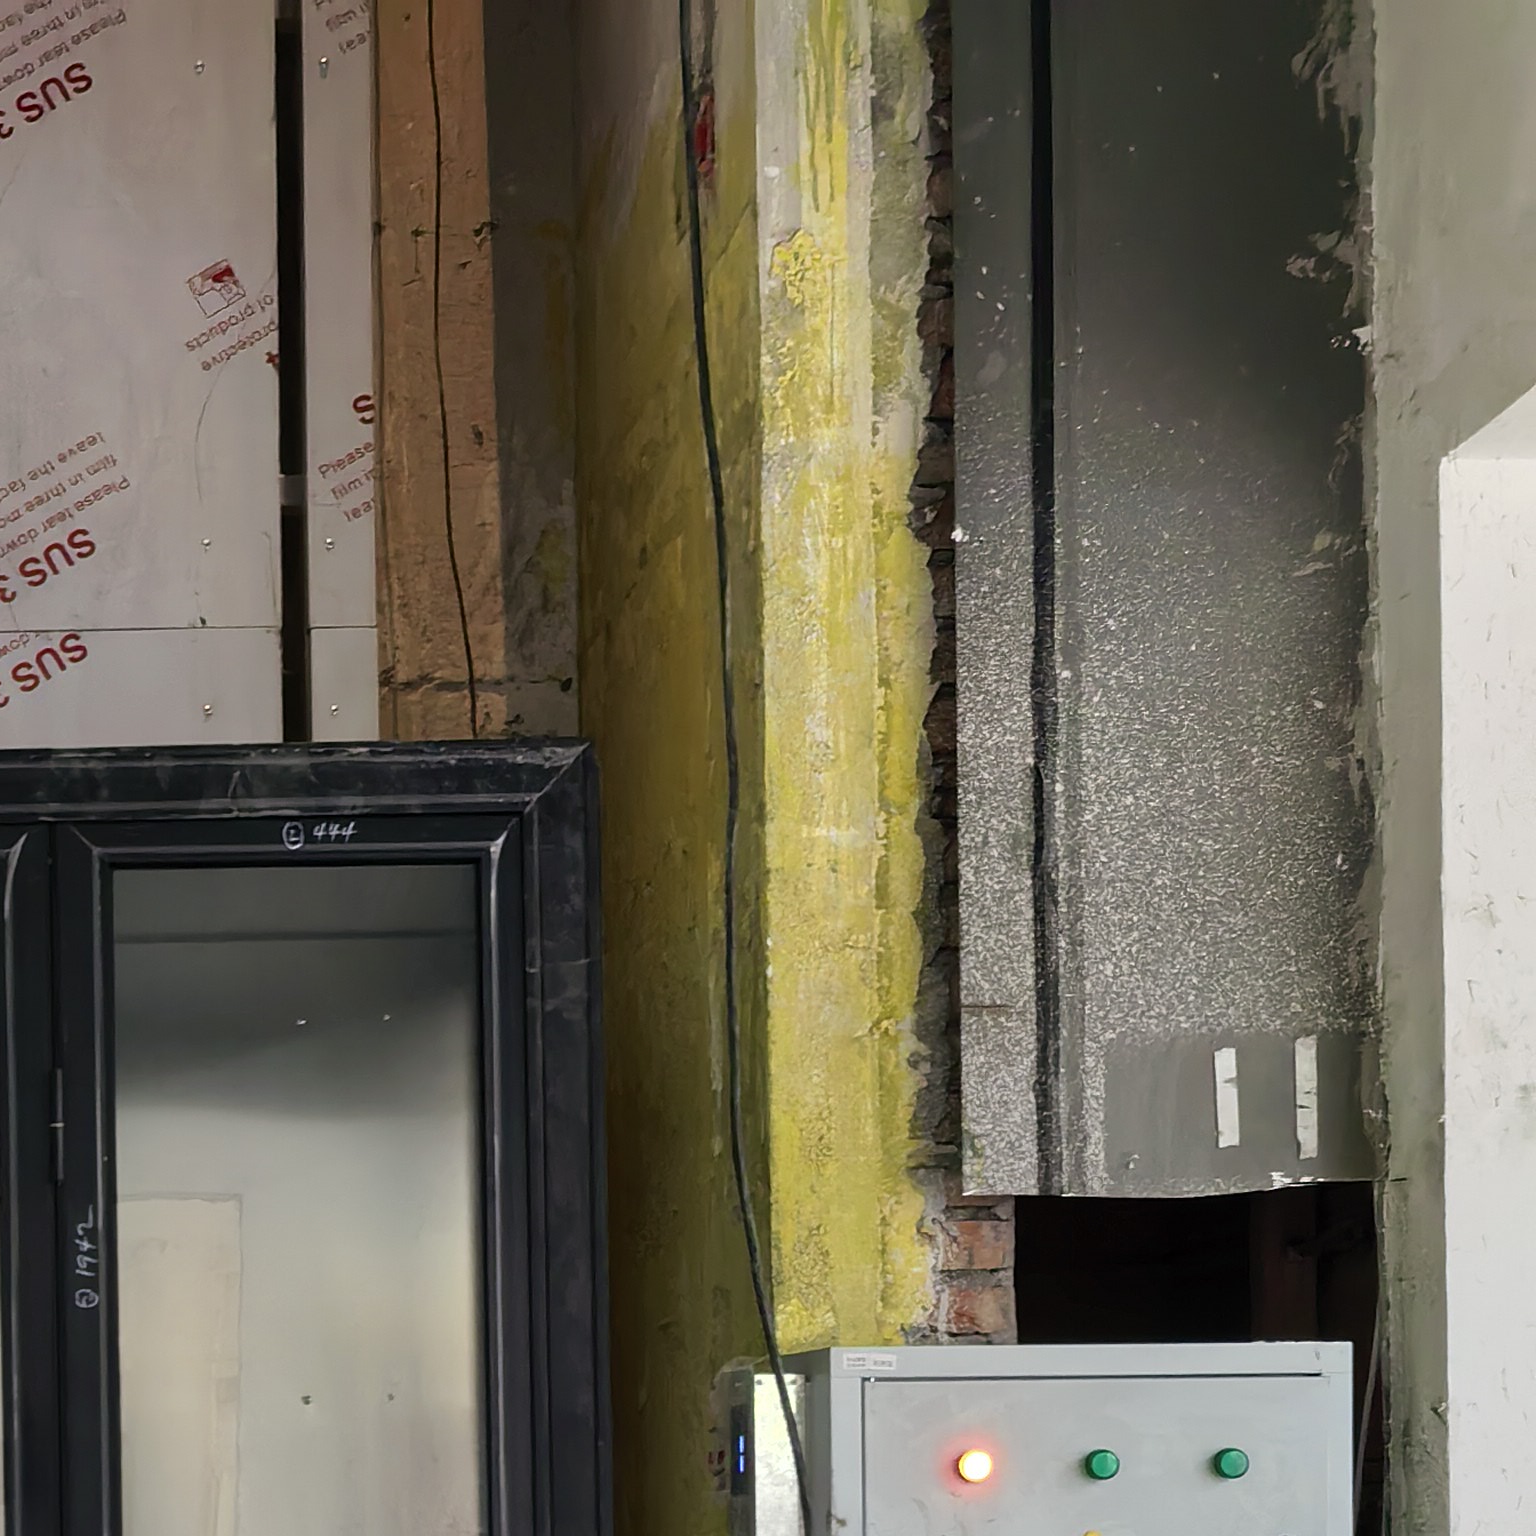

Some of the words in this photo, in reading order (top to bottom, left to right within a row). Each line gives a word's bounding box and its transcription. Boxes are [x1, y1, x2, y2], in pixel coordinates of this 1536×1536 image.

[15, 62, 93, 123] SUS
[28, 460, 55, 481] the
[73, 475, 131, 512] Please
[18, 528, 96, 587] SUS
[11, 633, 88, 692] SUS
